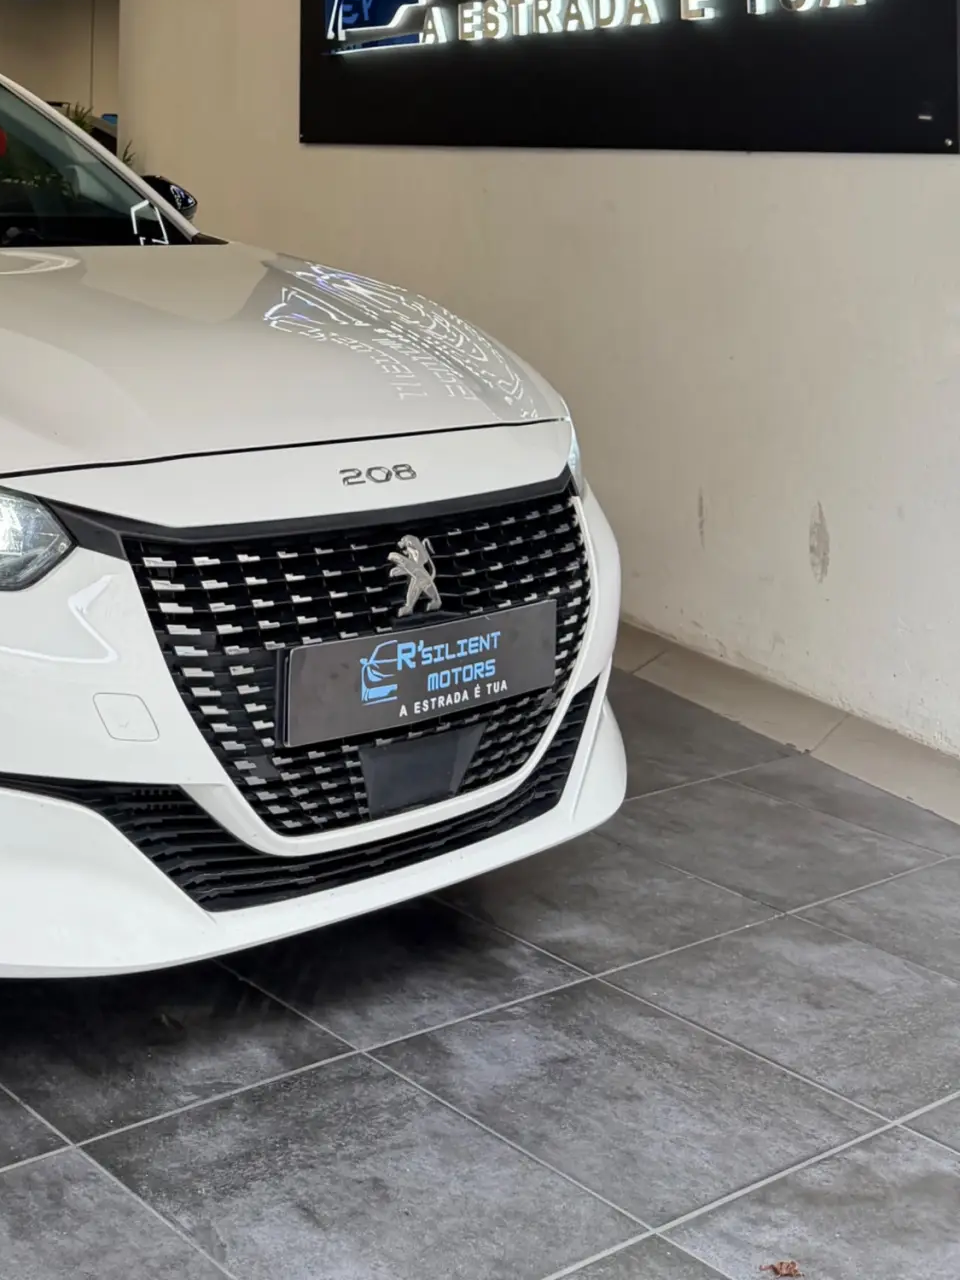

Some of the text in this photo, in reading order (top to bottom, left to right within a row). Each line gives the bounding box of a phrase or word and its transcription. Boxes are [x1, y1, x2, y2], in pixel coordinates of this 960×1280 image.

[422, 6, 448, 43] A
[339, 463, 417, 486] 208
[397, 631, 501, 671] R'SILIENT
[427, 658, 496, 692] MOTORS
[399, 679, 508, 717] A ESTRADA É TUA
